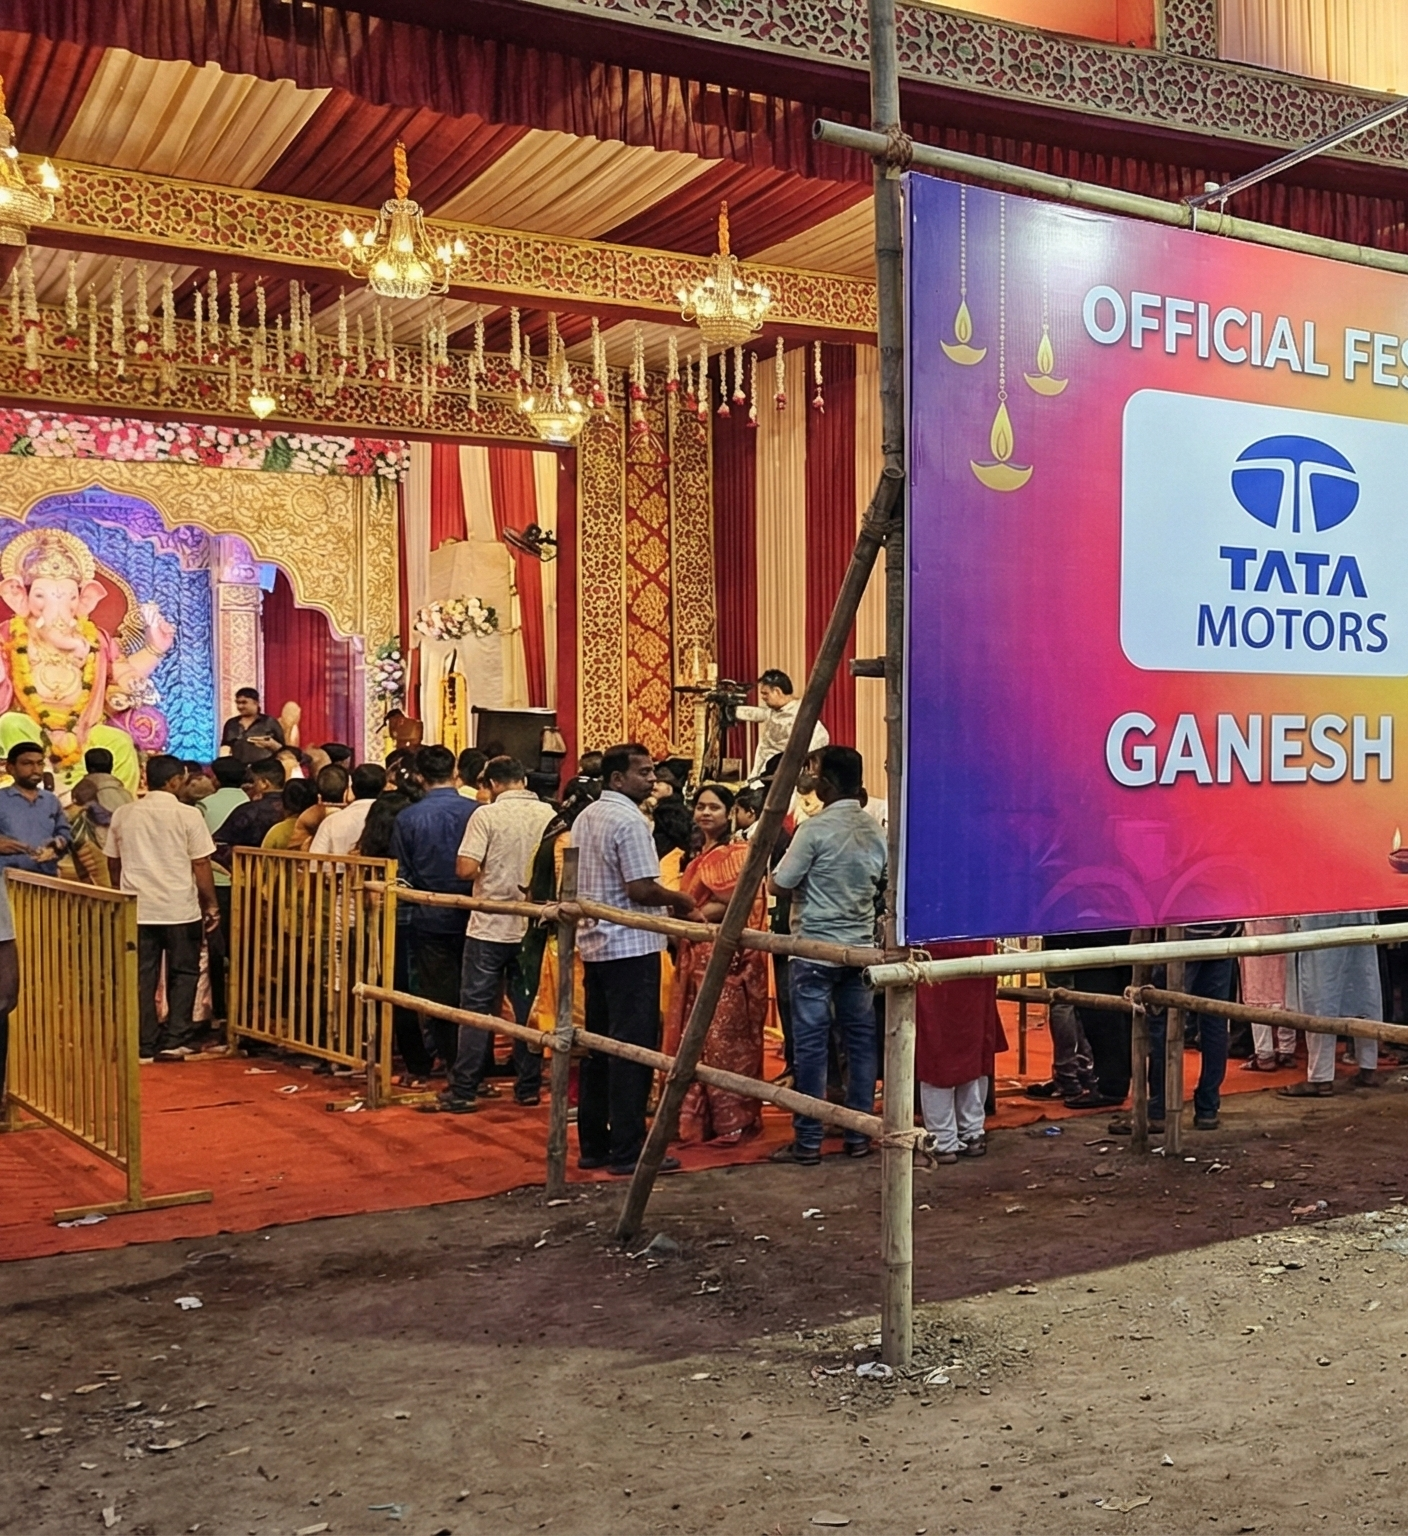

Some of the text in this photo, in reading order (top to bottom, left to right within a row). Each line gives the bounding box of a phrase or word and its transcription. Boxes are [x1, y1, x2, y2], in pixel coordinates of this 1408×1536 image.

[1083, 285, 1329, 377] OFFICIAL
[1219, 546, 1367, 598] TATA
[1197, 604, 1388, 653] MOTORS
[1106, 711, 1392, 787] GANESH
